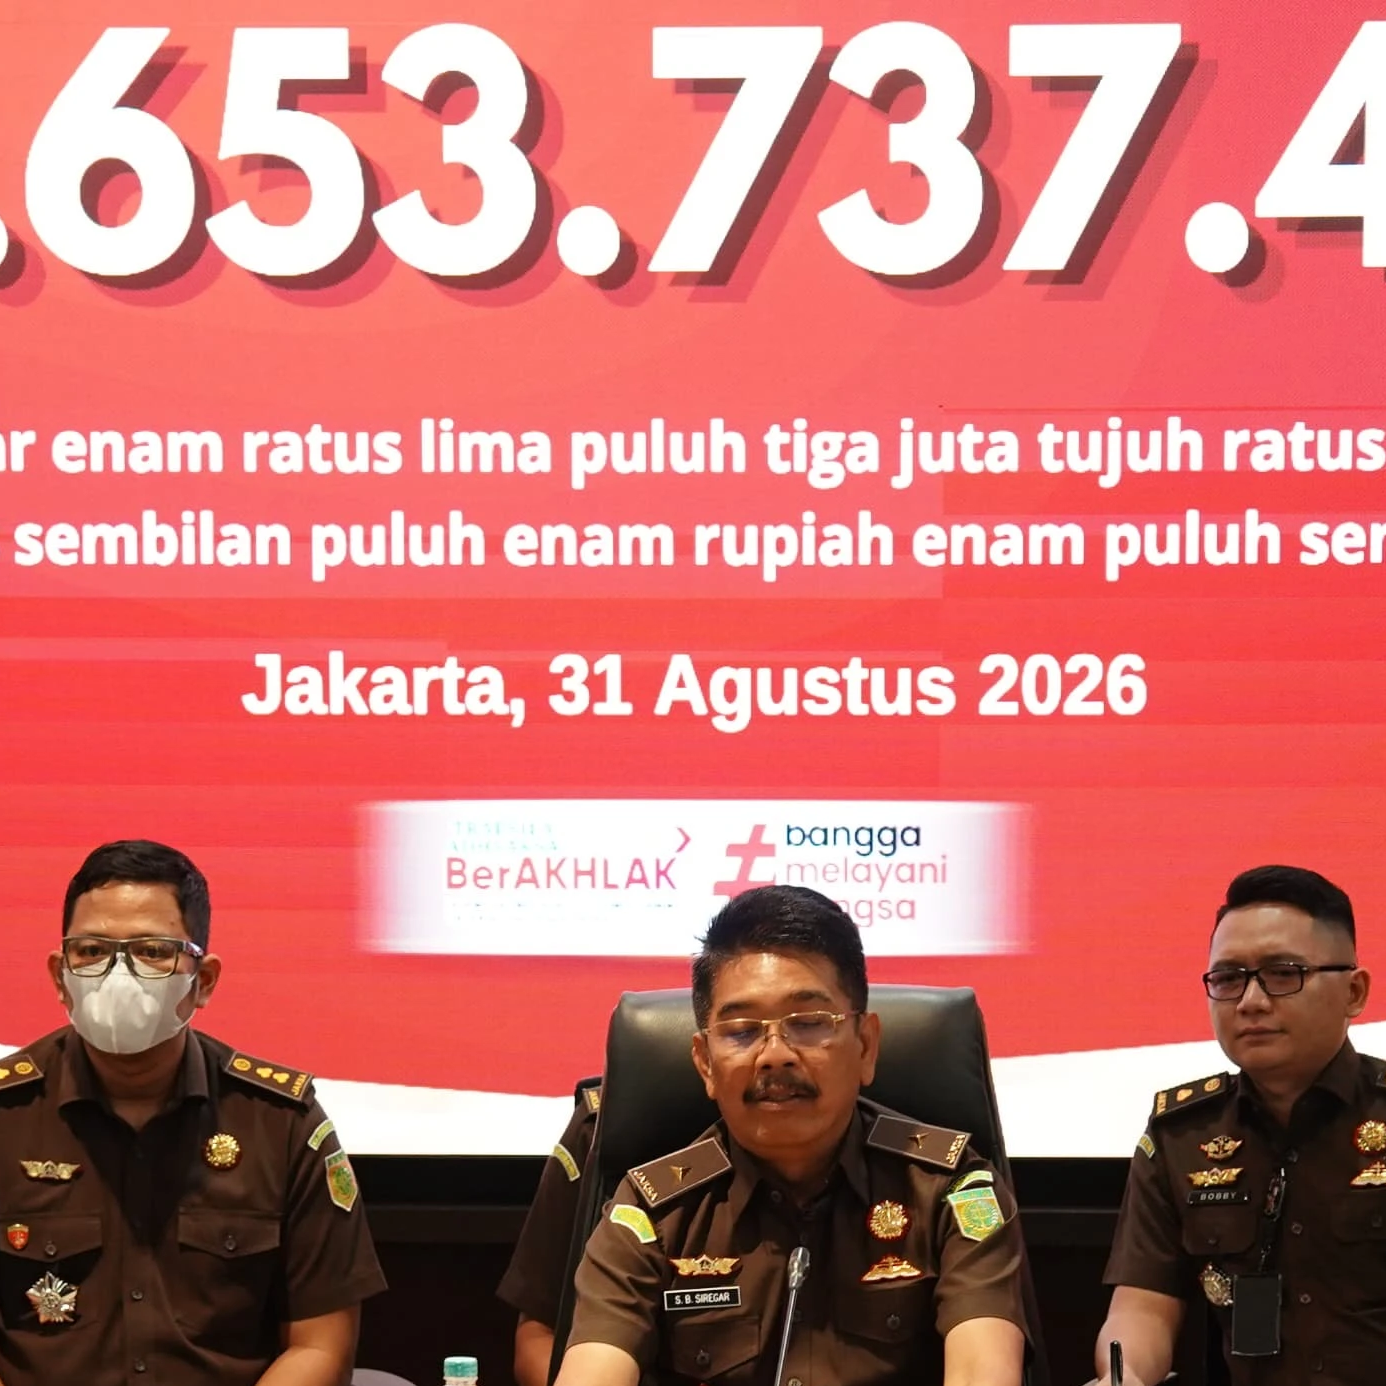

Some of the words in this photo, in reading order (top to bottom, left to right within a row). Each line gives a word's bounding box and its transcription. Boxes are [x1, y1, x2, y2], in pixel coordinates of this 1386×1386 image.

[51, 430, 223, 474] enam
[243, 423, 403, 475] ratus
[421, 417, 552, 474] lima
[571, 418, 746, 490] puluh
[763, 418, 879, 490] tiga
[891, 417, 1019, 489] juta
[1037, 416, 1203, 488] tujuh
[1223, 421, 1386, 472] ratus
[14, 509, 291, 567] sembilan
[311, 510, 485, 582] puluh
[503, 523, 674, 567] enam
[695, 510, 894, 583] rupiah
[912, 523, 1085, 567] enam
[1105, 508, 1281, 582] puluh
[241, 650, 525, 728] Jakarta,
[549, 653, 633, 716] 31
[654, 654, 956, 733] Agustus
[978, 653, 1147, 716] 2026
[786, 824, 922, 857] bangga
[446, 857, 676, 890] BerAKHLAK
[786, 854, 948, 893] melayani
[1200, 1191, 1237, 1202] BOBBY
[695, 1292, 729, 1304] SIREGAR
